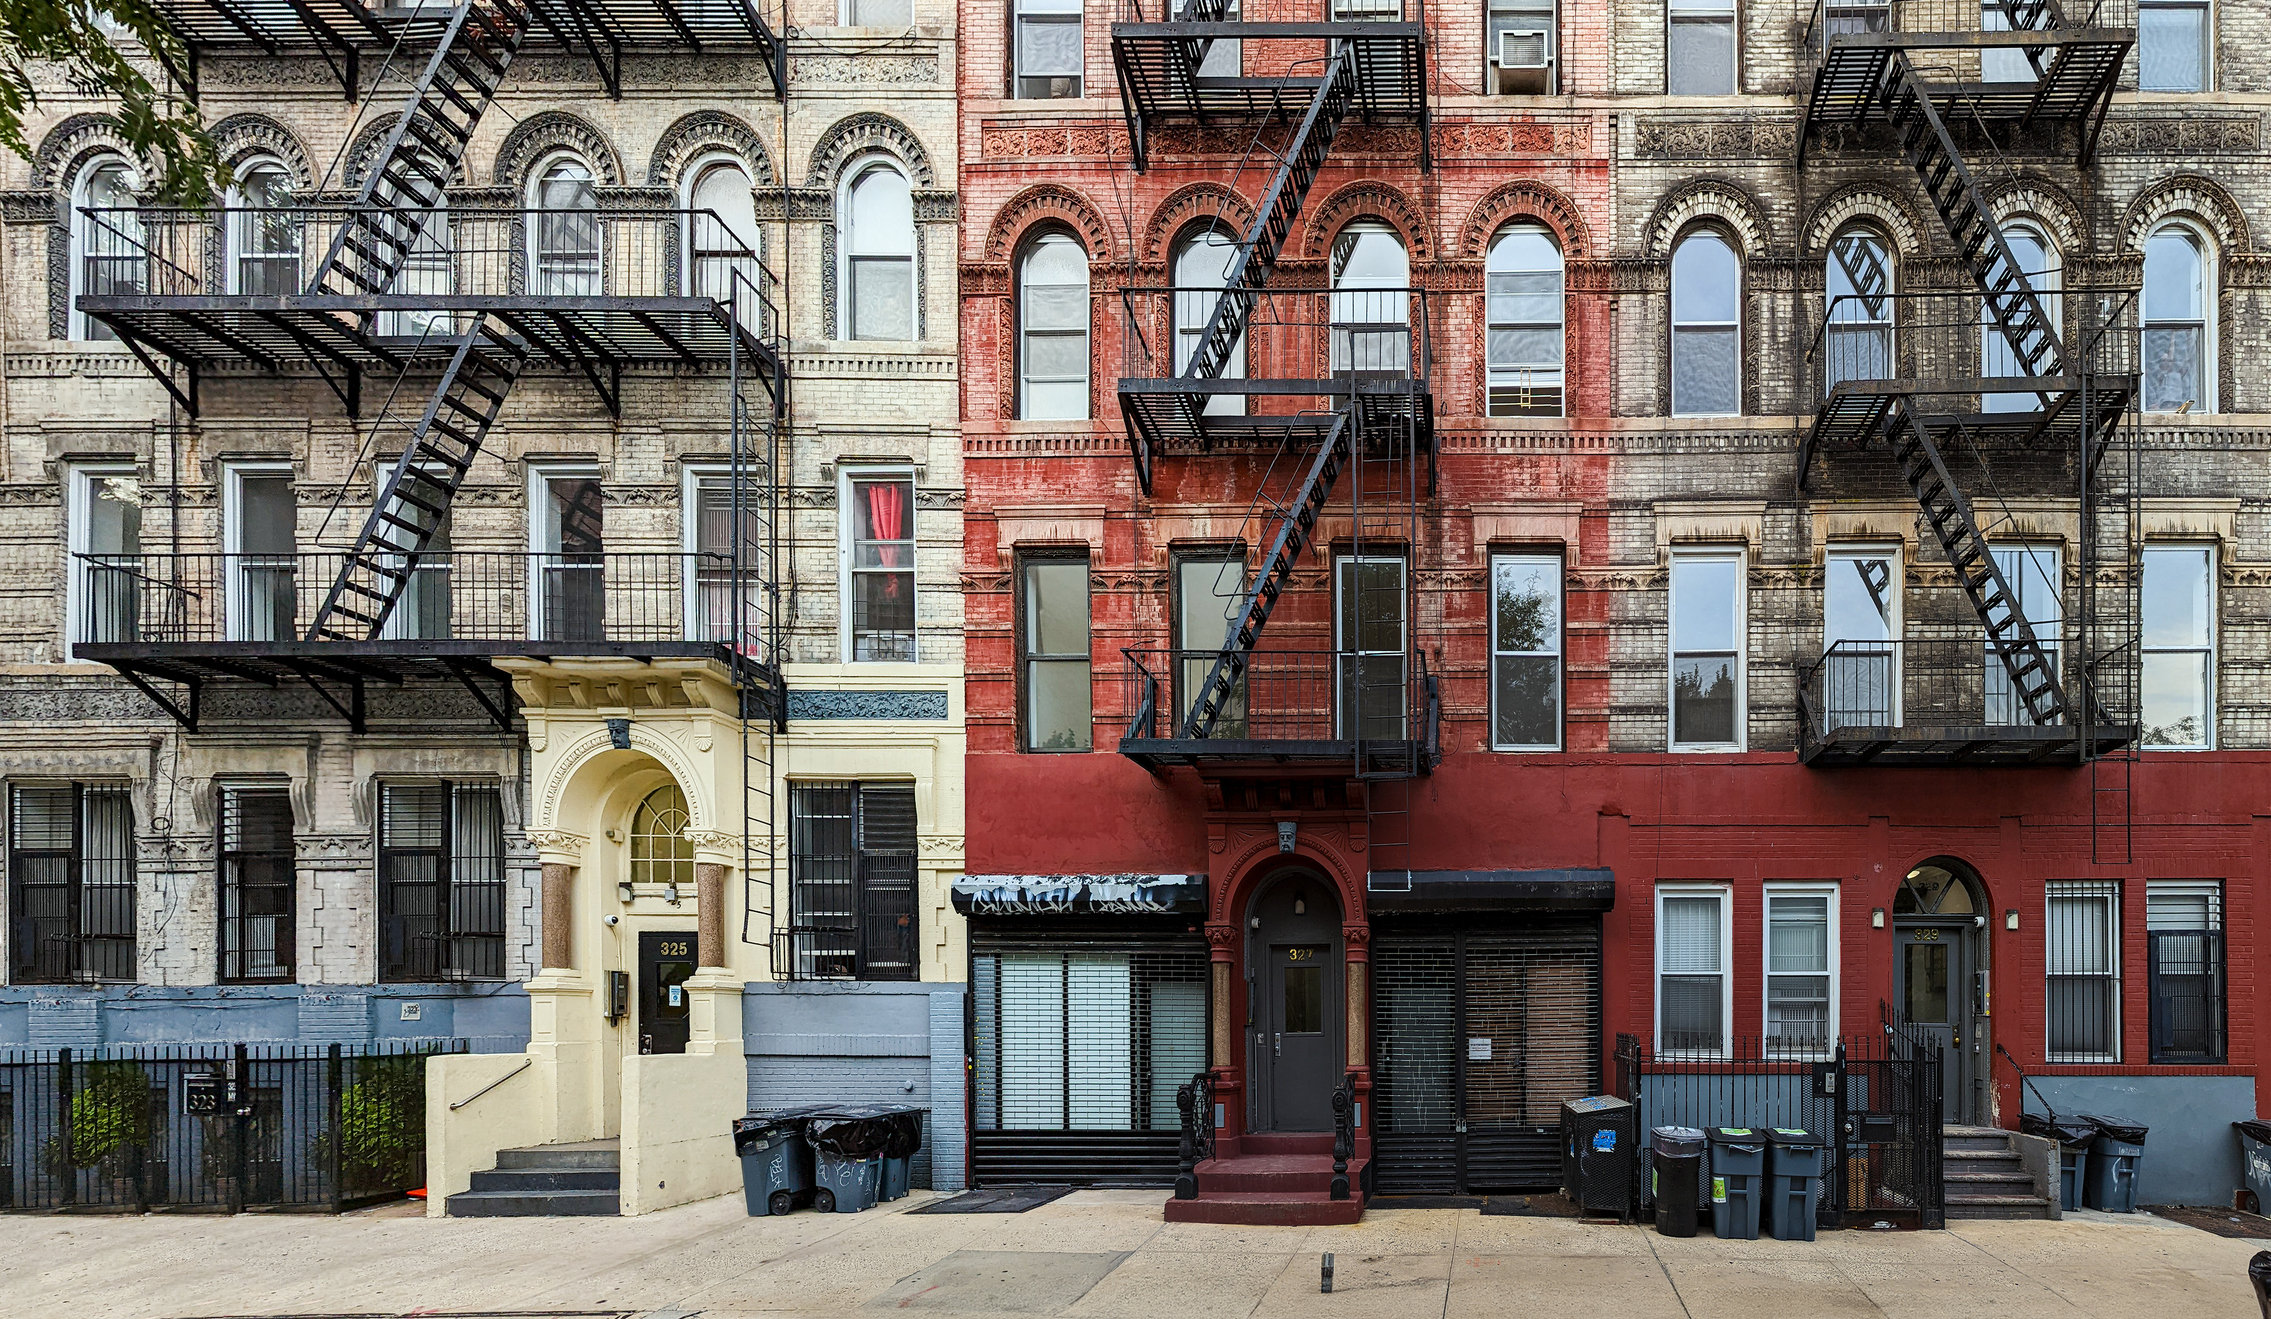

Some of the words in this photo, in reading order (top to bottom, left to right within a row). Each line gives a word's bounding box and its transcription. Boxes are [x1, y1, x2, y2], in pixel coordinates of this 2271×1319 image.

[1919, 882, 1939, 892] 329
[1913, 928, 1939, 941] 329
[661, 942, 688, 956] 325
[1290, 949, 1314, 960] 327
[189, 1094, 216, 1110] 323
